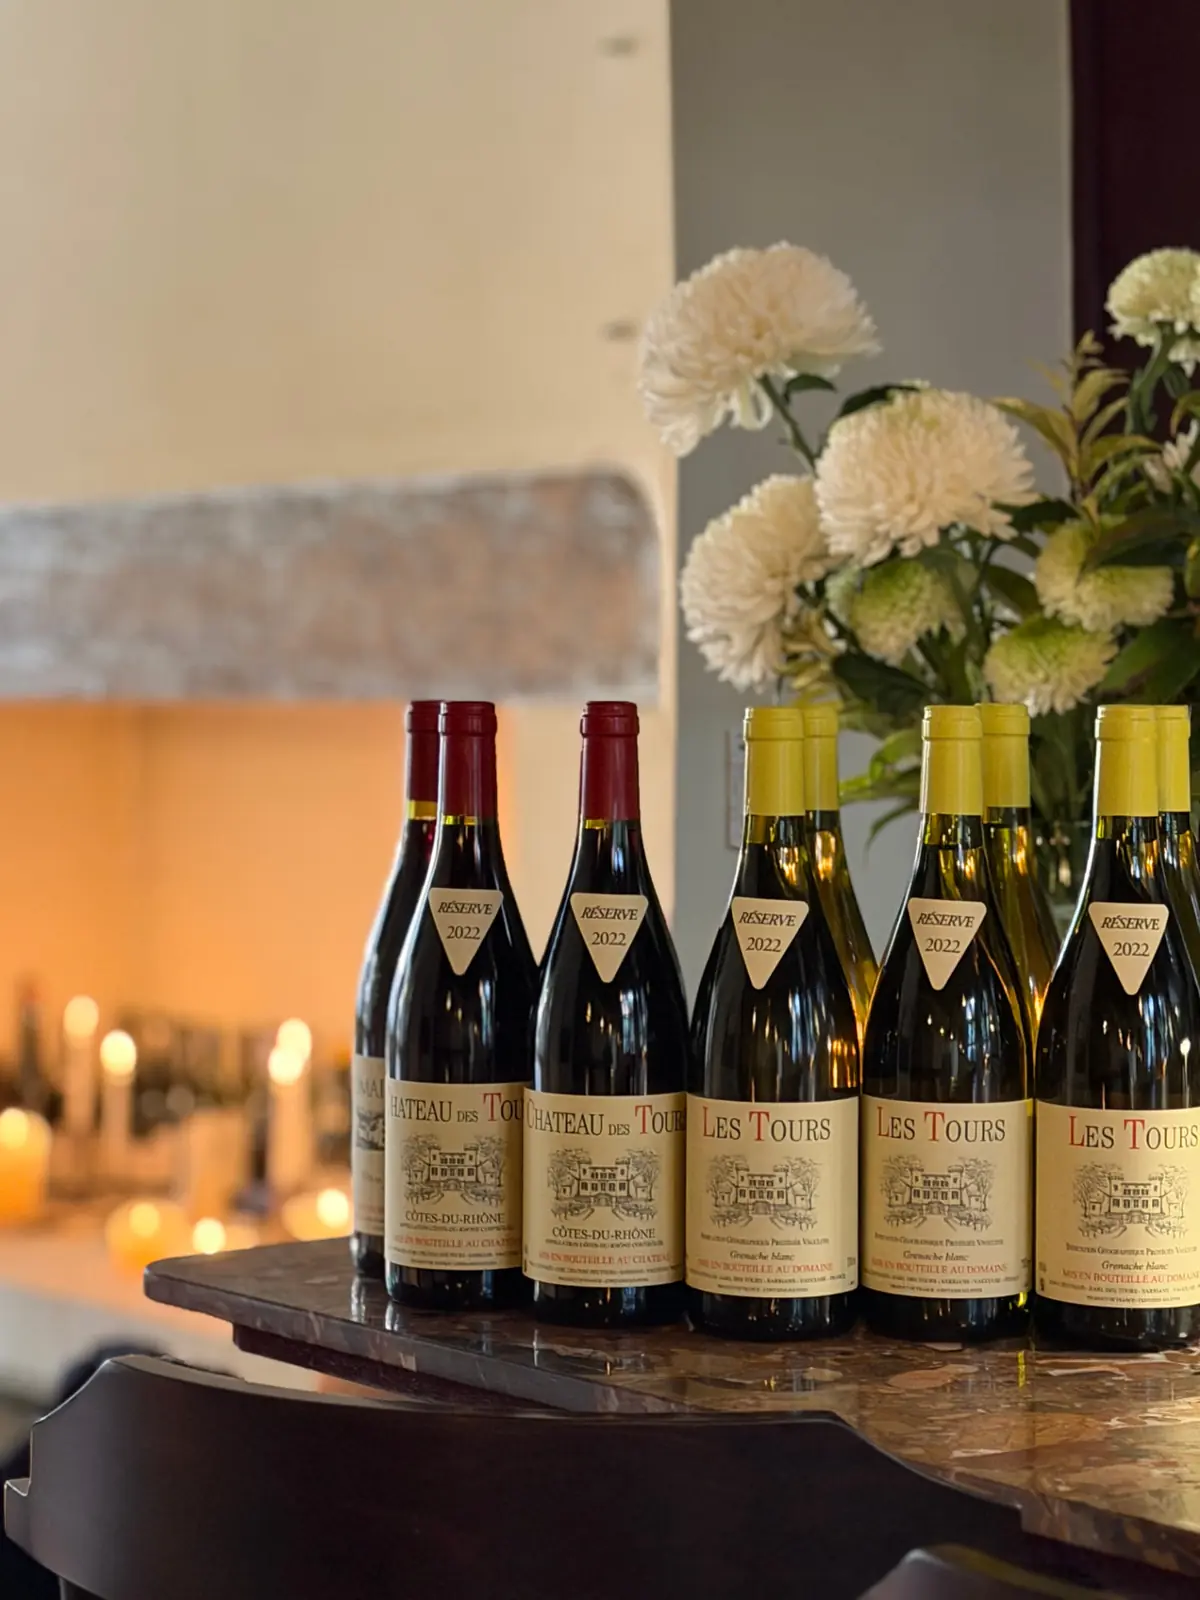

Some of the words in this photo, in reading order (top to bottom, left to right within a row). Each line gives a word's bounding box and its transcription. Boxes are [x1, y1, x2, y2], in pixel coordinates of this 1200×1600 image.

[437, 900, 493, 915] RÉSERVE
[580, 905, 638, 921] RÉSERVE
[738, 910, 797, 927] RÉSERVE
[916, 910, 976, 928] RÉSERVE
[1101, 915, 1160, 930] RÉSERVE
[446, 925, 481, 940] 2022
[591, 931, 627, 946] 2022
[745, 936, 782, 953] 2022
[924, 937, 961, 954] 2022
[1112, 942, 1150, 957] 2022
[391, 1095, 453, 1123] HATEAU
[456, 1109, 479, 1123] DES
[482, 1092, 523, 1122] TOU
[526, 1098, 605, 1137] CHATEAU
[607, 1123, 631, 1136] DES
[702, 1106, 742, 1139] LES
[748, 1110, 831, 1142] TOURS
[876, 1106, 916, 1140] LES
[923, 1111, 1006, 1143] TOURS
[1068, 1115, 1115, 1149] LES
[1123, 1119, 1199, 1150] TOURS
[405, 1208, 506, 1225] CÔTES-DU-RHÔNE
[551, 1224, 656, 1241] CÔTES-DU-RHÔNE
[466, 1239, 479, 1249] AU
[617, 1255, 630, 1266] AU
[729, 1249, 769, 1261] Grenache
[902, 1250, 943, 1262] Grenache
[944, 1250, 970, 1262] blanc
[722, 1261, 774, 1275] BOUTEILLE
[776, 1264, 790, 1275] AU
[792, 1262, 834, 1274] DOMAINE
[896, 1260, 948, 1275] BOUTEILLE
[950, 1264, 965, 1275] AU
[1101, 1260, 1144, 1271] Grenache
[1093, 1272, 1149, 1284] BOUTEILLE
[1151, 1273, 1164, 1284] AU
